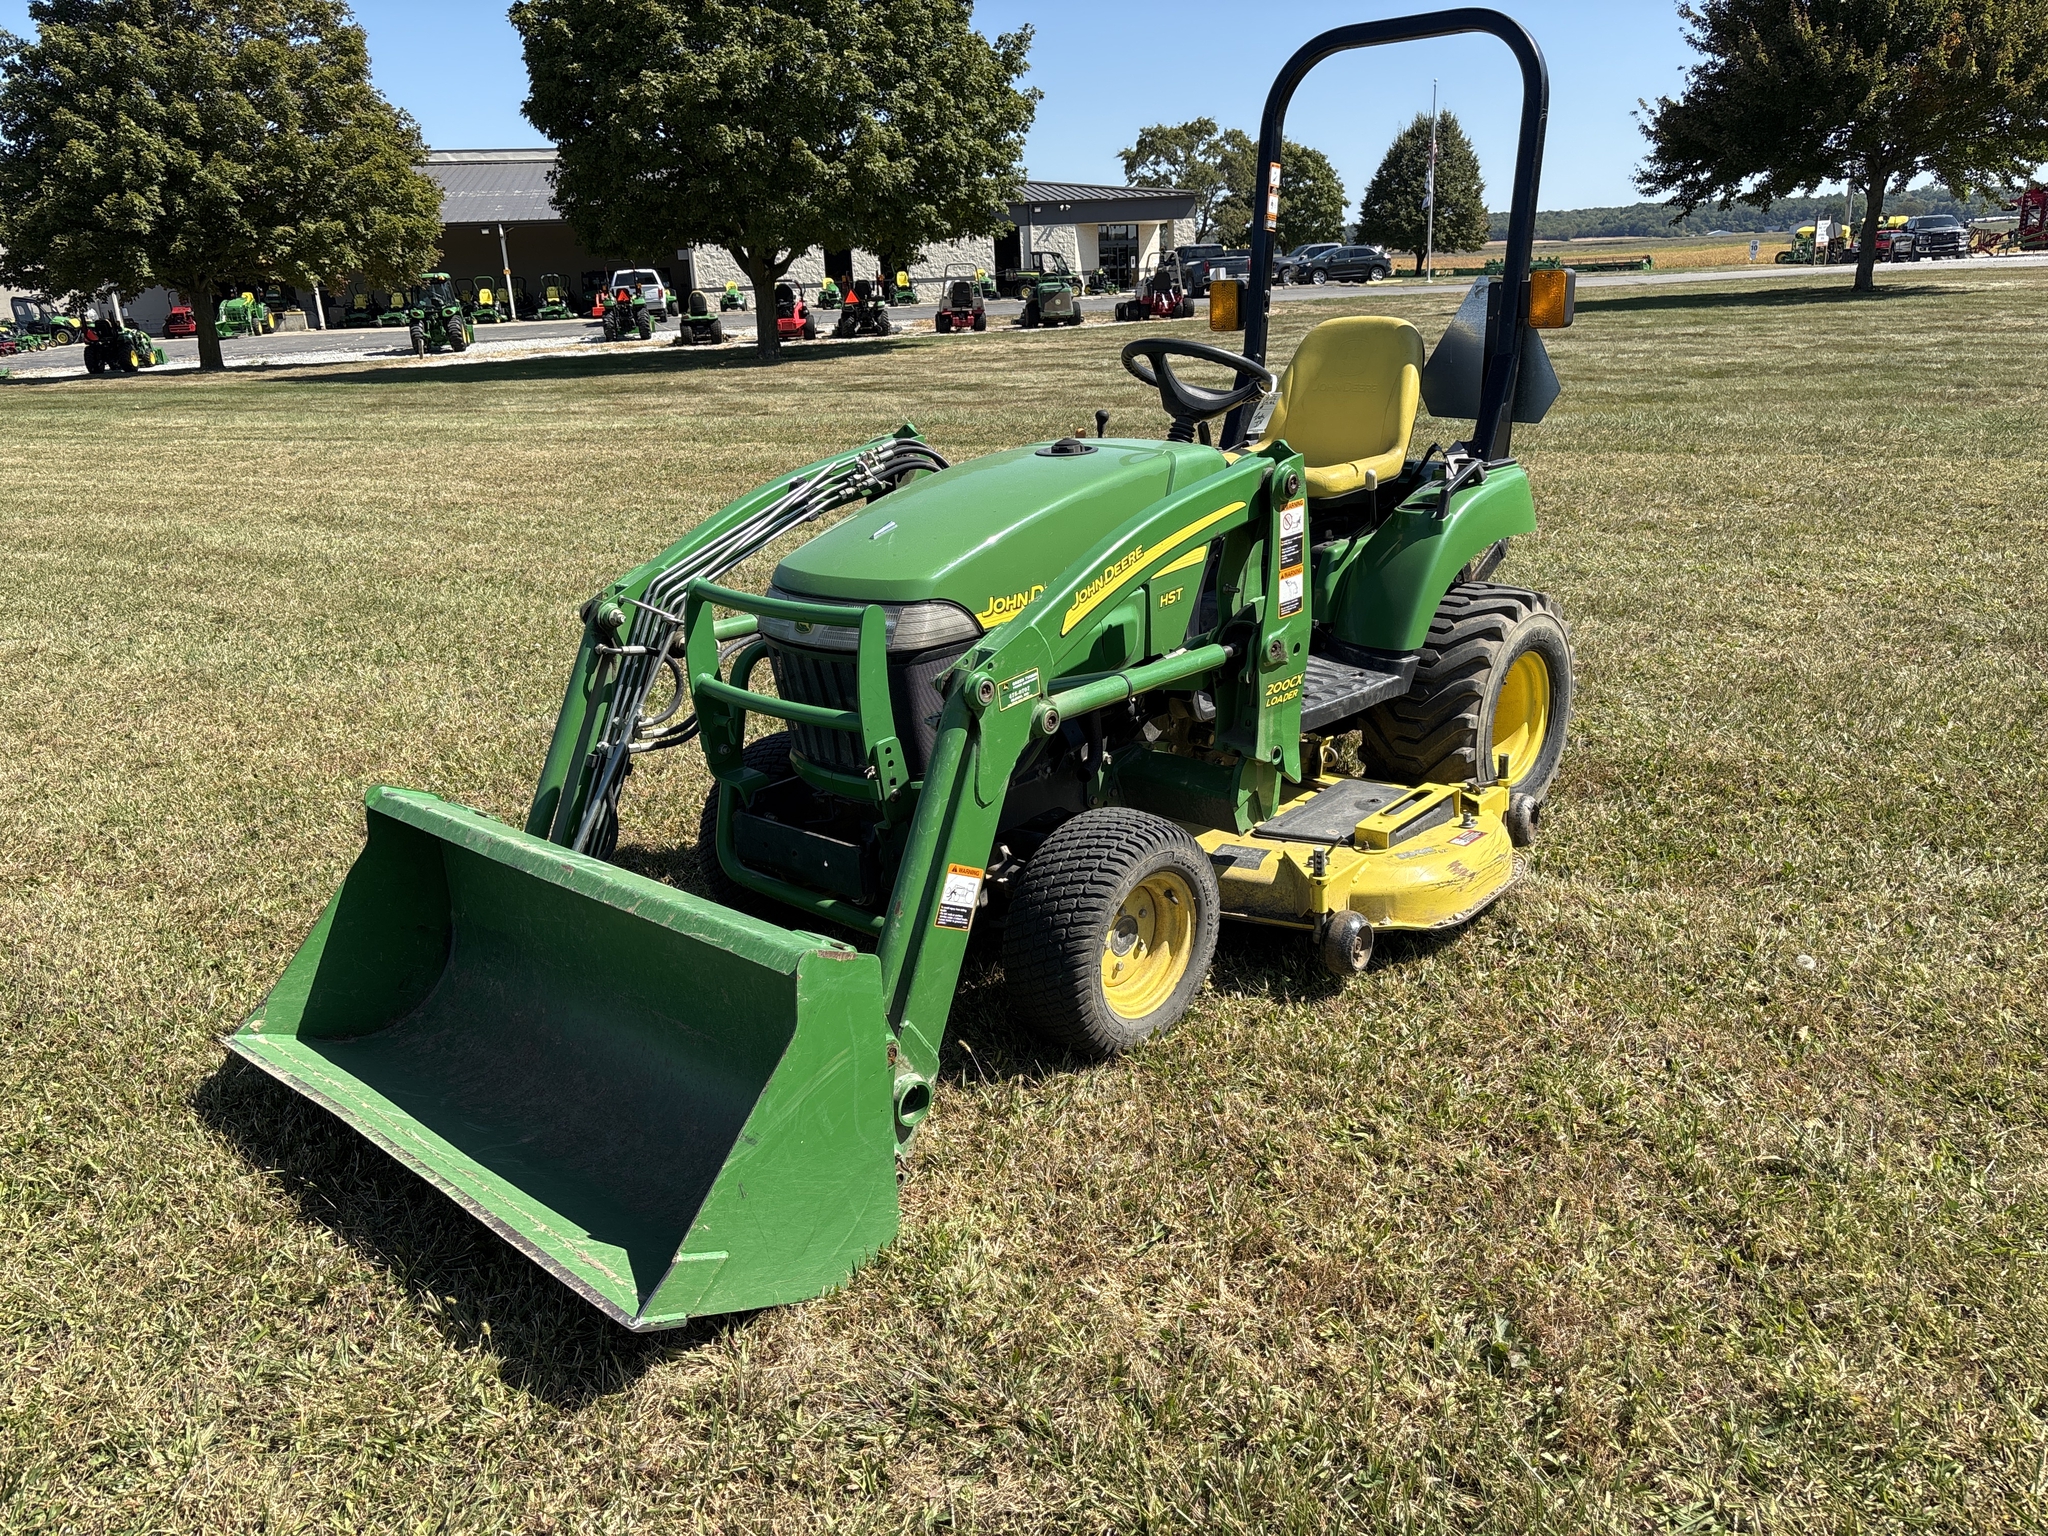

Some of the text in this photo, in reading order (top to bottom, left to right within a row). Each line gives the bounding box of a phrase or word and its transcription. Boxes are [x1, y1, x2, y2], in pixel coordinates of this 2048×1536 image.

[1071, 575, 1104, 611] JOHN
[1104, 544, 1145, 586] DEERE
[981, 590, 1029, 618] JOHN
[1159, 586, 1184, 609] HST
[1265, 672, 1305, 697] 200CX
[1265, 688, 1299, 708] LOADER
[958, 867, 980, 876] WARNING
